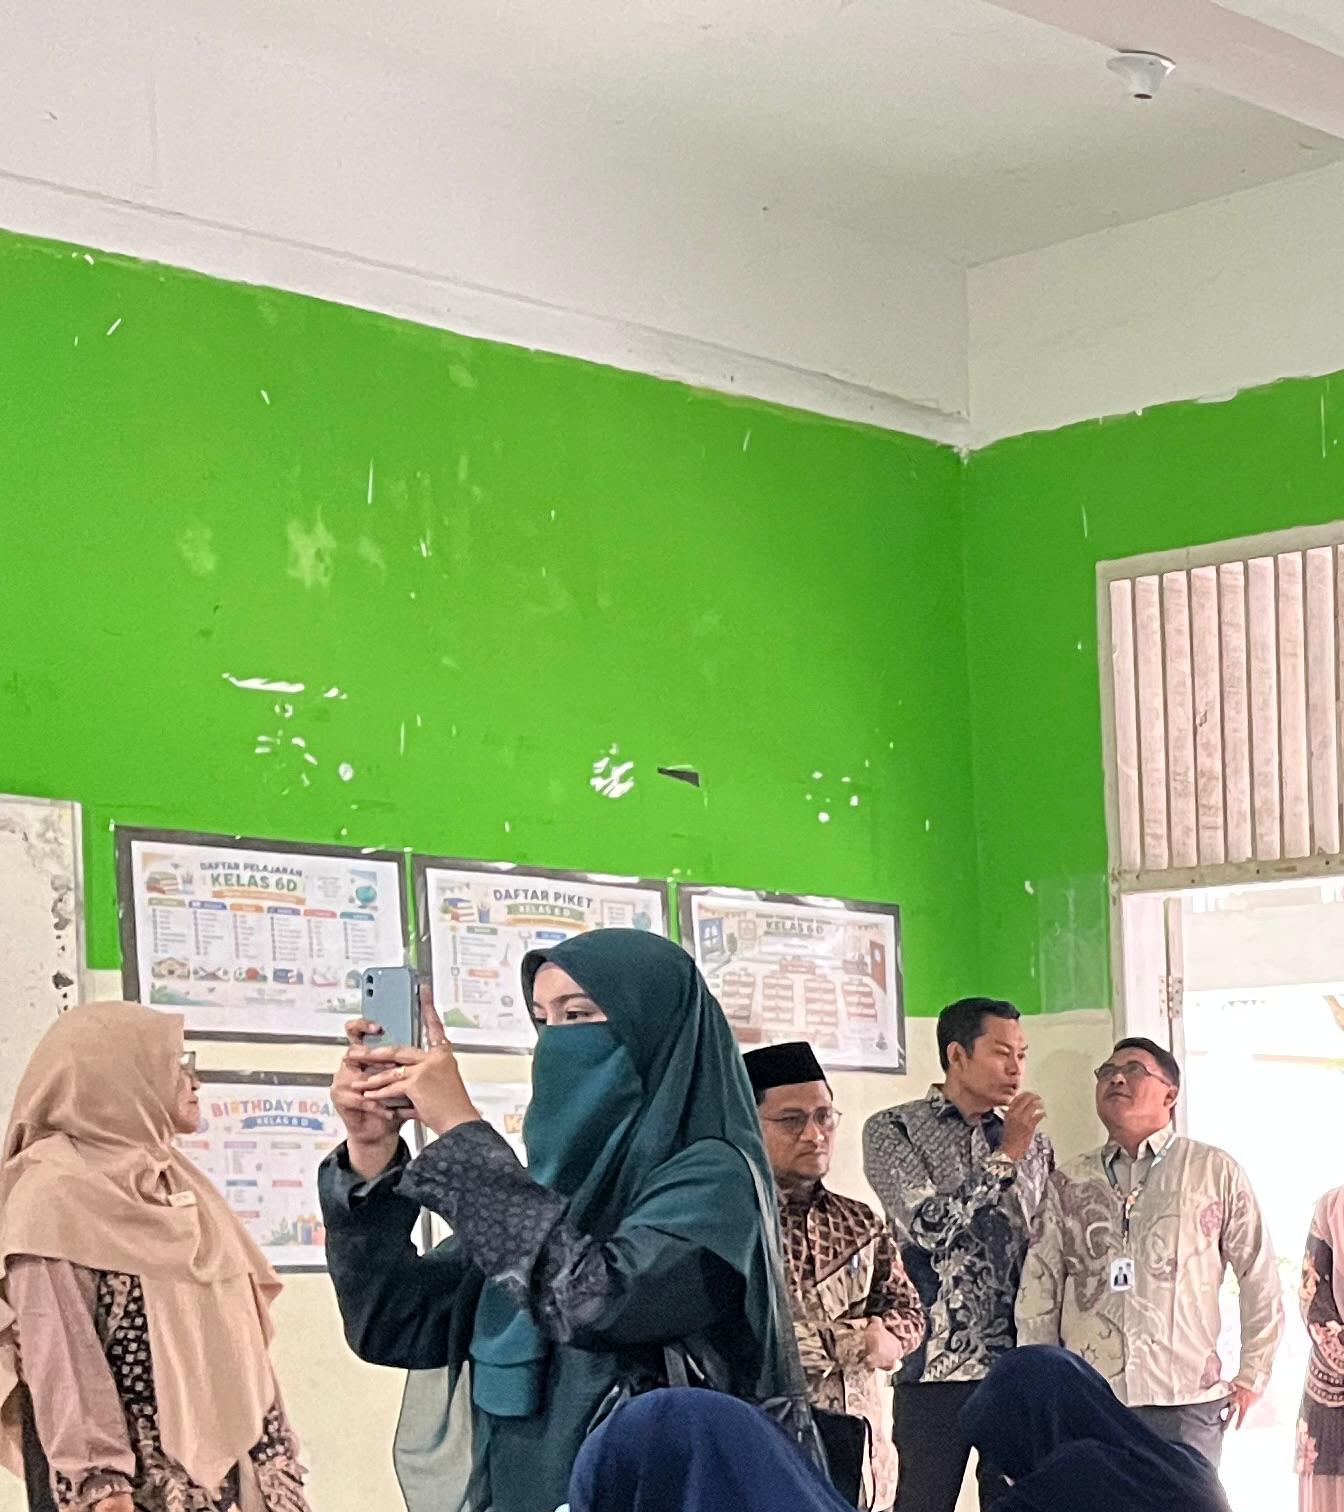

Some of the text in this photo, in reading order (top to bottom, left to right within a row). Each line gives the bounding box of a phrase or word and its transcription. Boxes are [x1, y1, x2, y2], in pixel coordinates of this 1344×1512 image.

[200, 861, 303, 877] DAFTAR PELAJARAN
[210, 872, 298, 892] KELAS 6D
[493, 888, 593, 909] DAFTAR PIKET
[210, 1099, 294, 1117] BIRTHDAY
